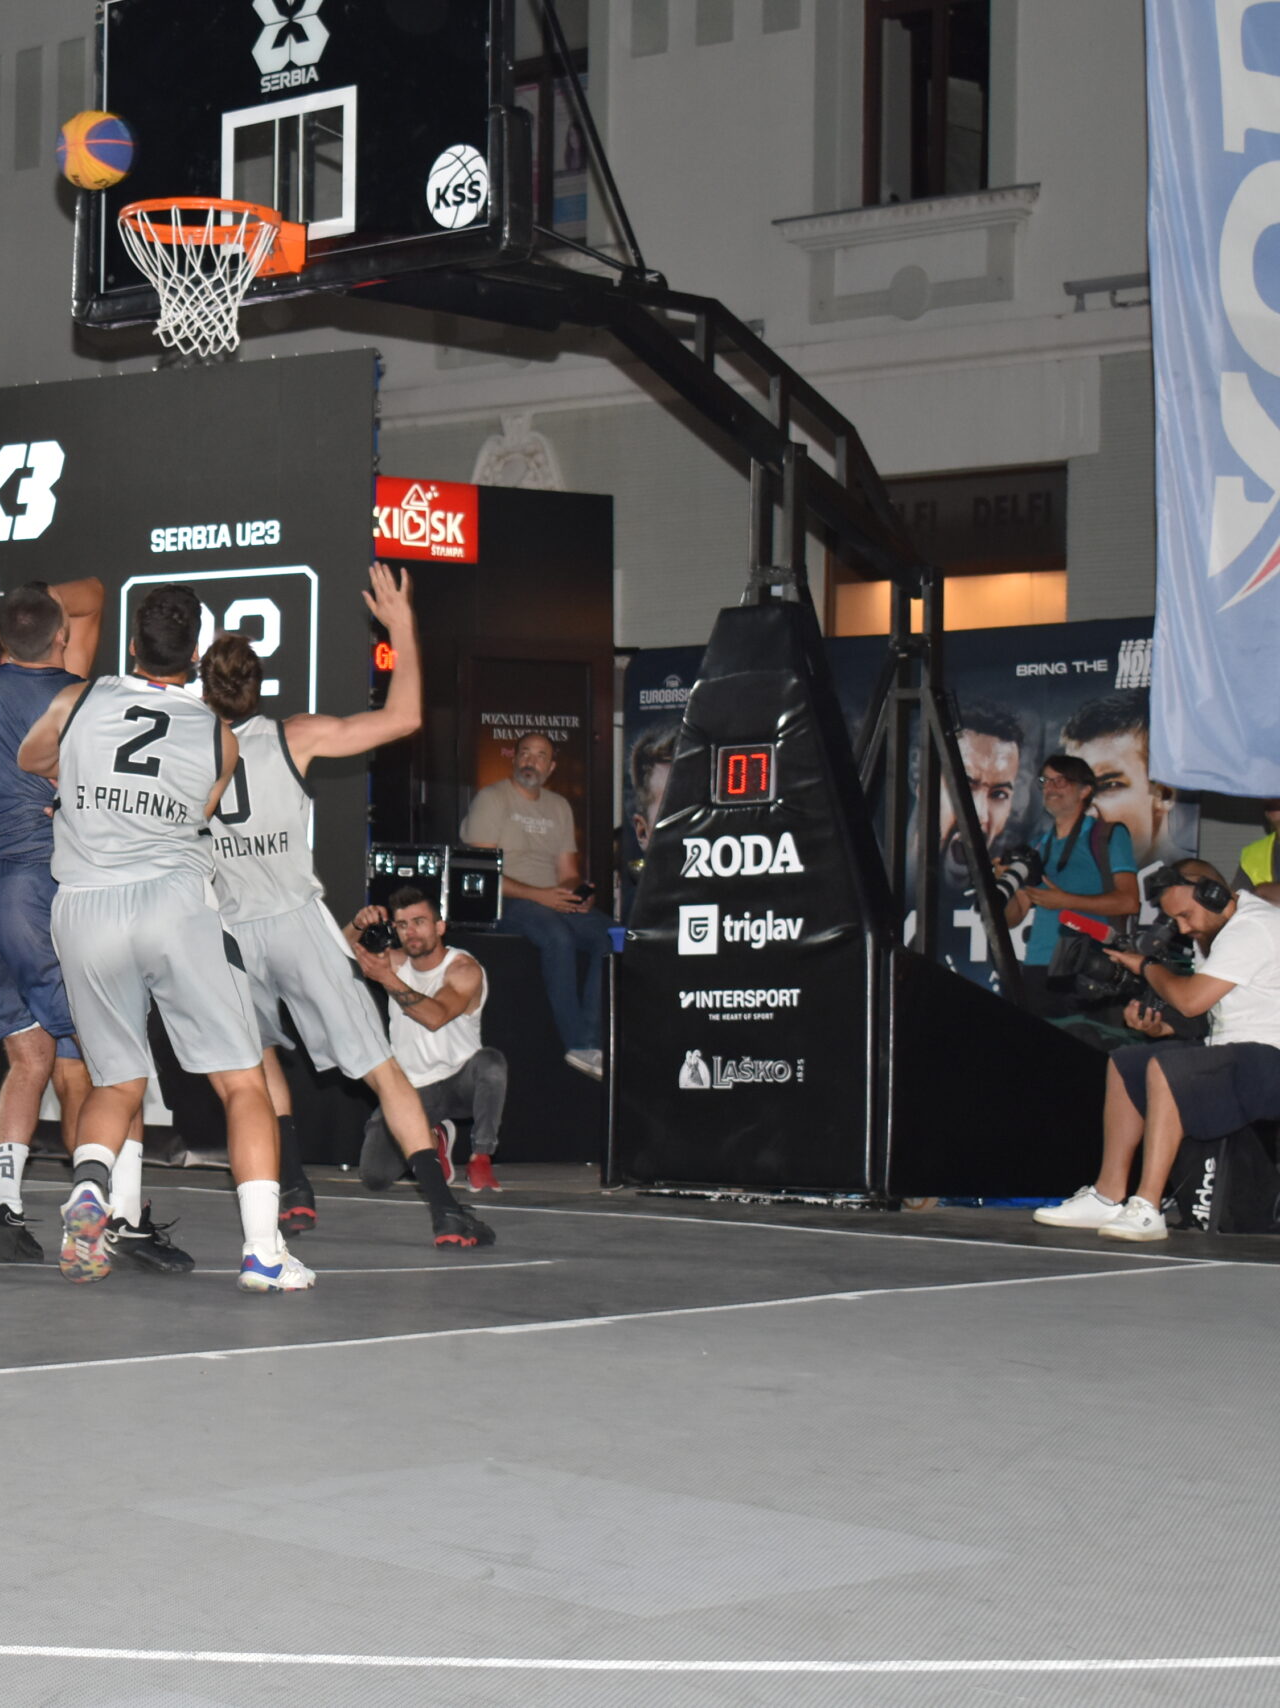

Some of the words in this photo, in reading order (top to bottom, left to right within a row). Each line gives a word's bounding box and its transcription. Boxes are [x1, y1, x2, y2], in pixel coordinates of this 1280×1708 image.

[260, 66, 319, 93] SERBIA
[434, 180, 482, 209] KSS
[972, 491, 1053, 526] DELFI
[150, 524, 232, 553] SERBIA
[236, 520, 281, 546] U23
[372, 505, 466, 547] KIOSK
[1016, 662, 1068, 677] BRING
[1072, 659, 1109, 673] THE
[481, 712, 523, 726] POZNATI
[525, 714, 580, 728] KARAKTER
[113, 704, 171, 778] 2
[727, 753, 769, 794] 07
[680, 832, 805, 878] RODA
[722, 910, 804, 949] triglav
[695, 988, 801, 1008] INTERSPORT
[708, 1013, 720, 1021] THE
[722, 1013, 742, 1021] HEART
[743, 1013, 752, 1021] OF
[753, 1012, 774, 1020] SPORT
[711, 1056, 792, 1090] LAŠKO
